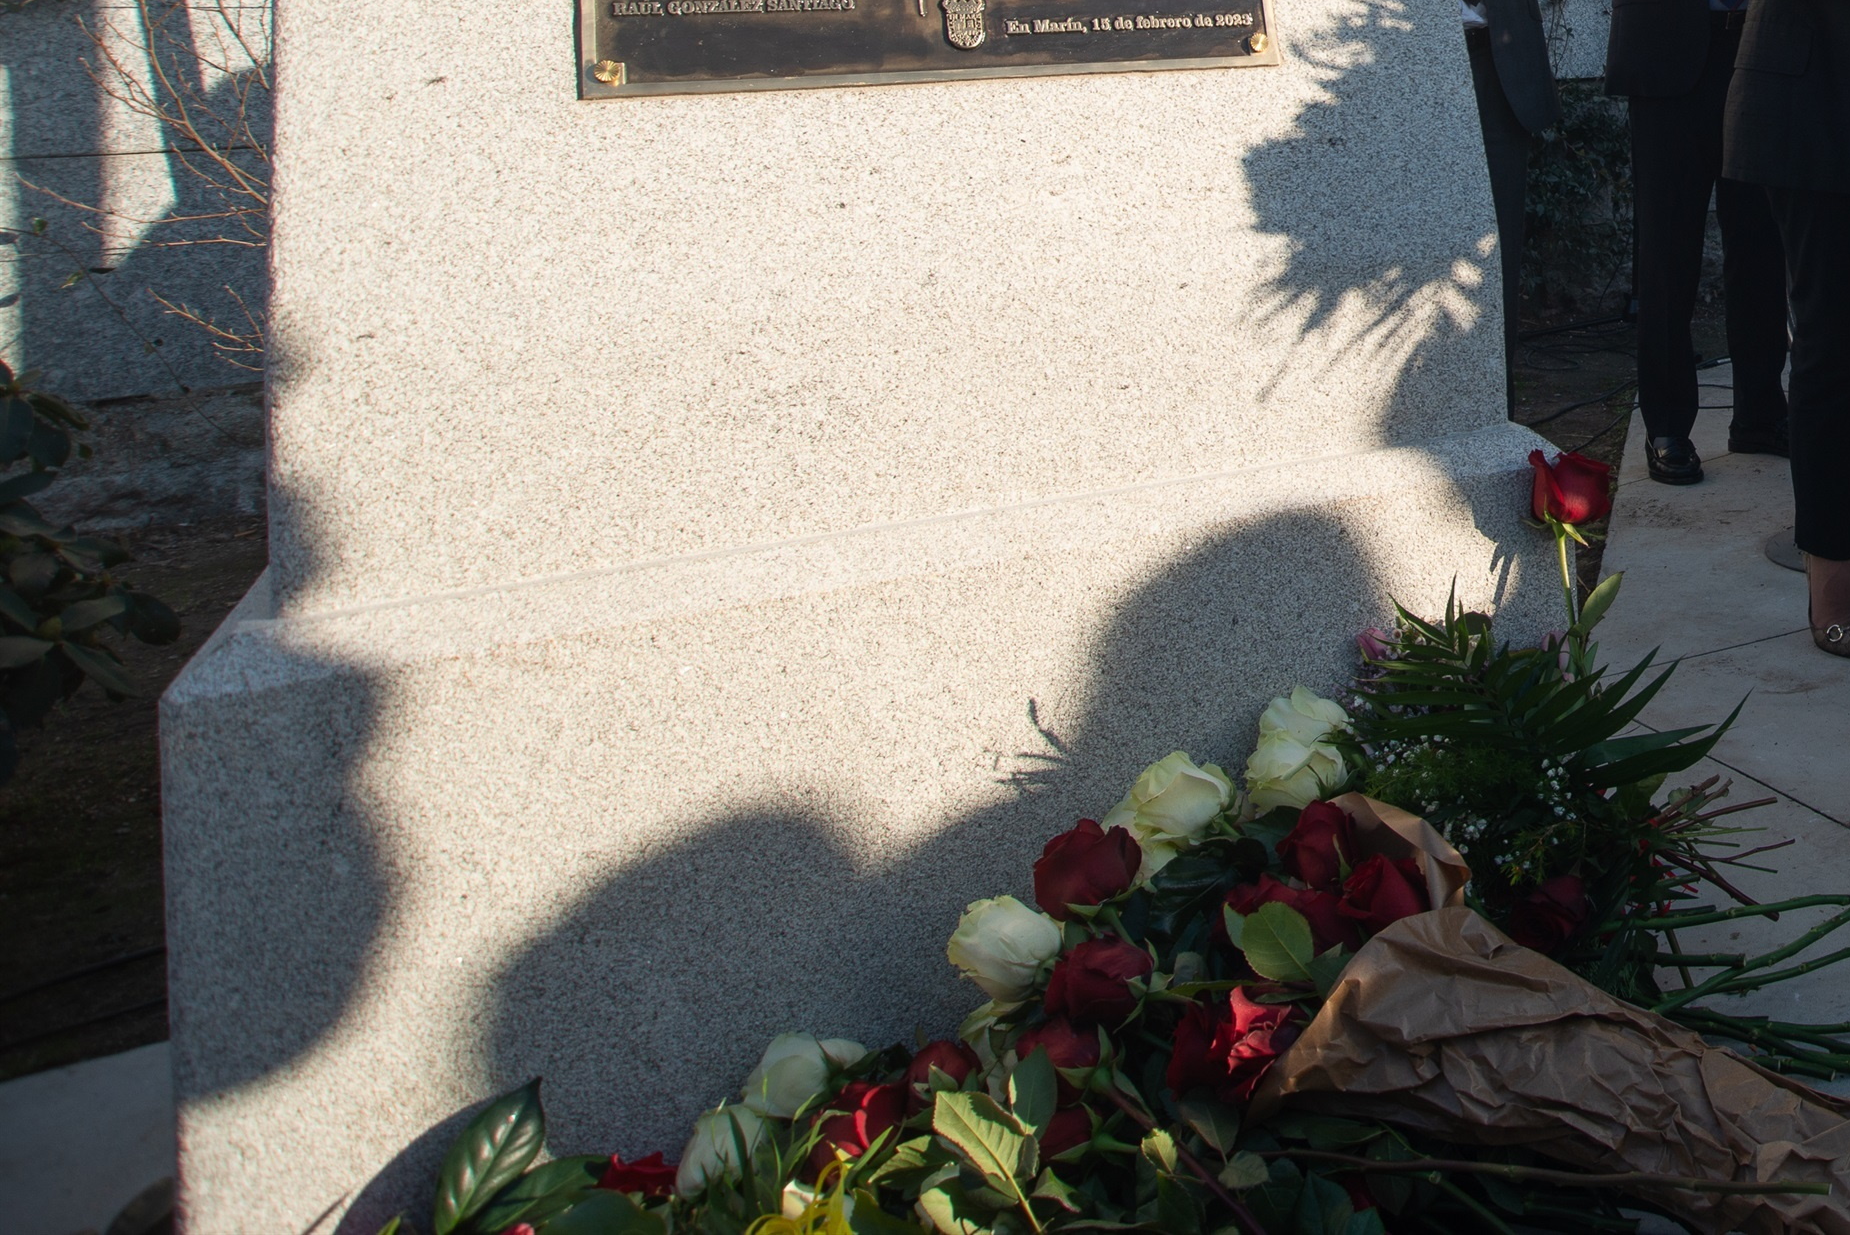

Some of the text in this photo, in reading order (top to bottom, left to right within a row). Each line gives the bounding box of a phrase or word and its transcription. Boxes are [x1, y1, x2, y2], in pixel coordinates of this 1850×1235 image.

[1005, 19, 1031, 35] En
[1033, 17, 1087, 35] Marín,
[1092, 18, 1111, 31] 15
[1113, 16, 1134, 31] de
[1135, 14, 1191, 29] febrero
[1194, 14, 1213, 28] de
